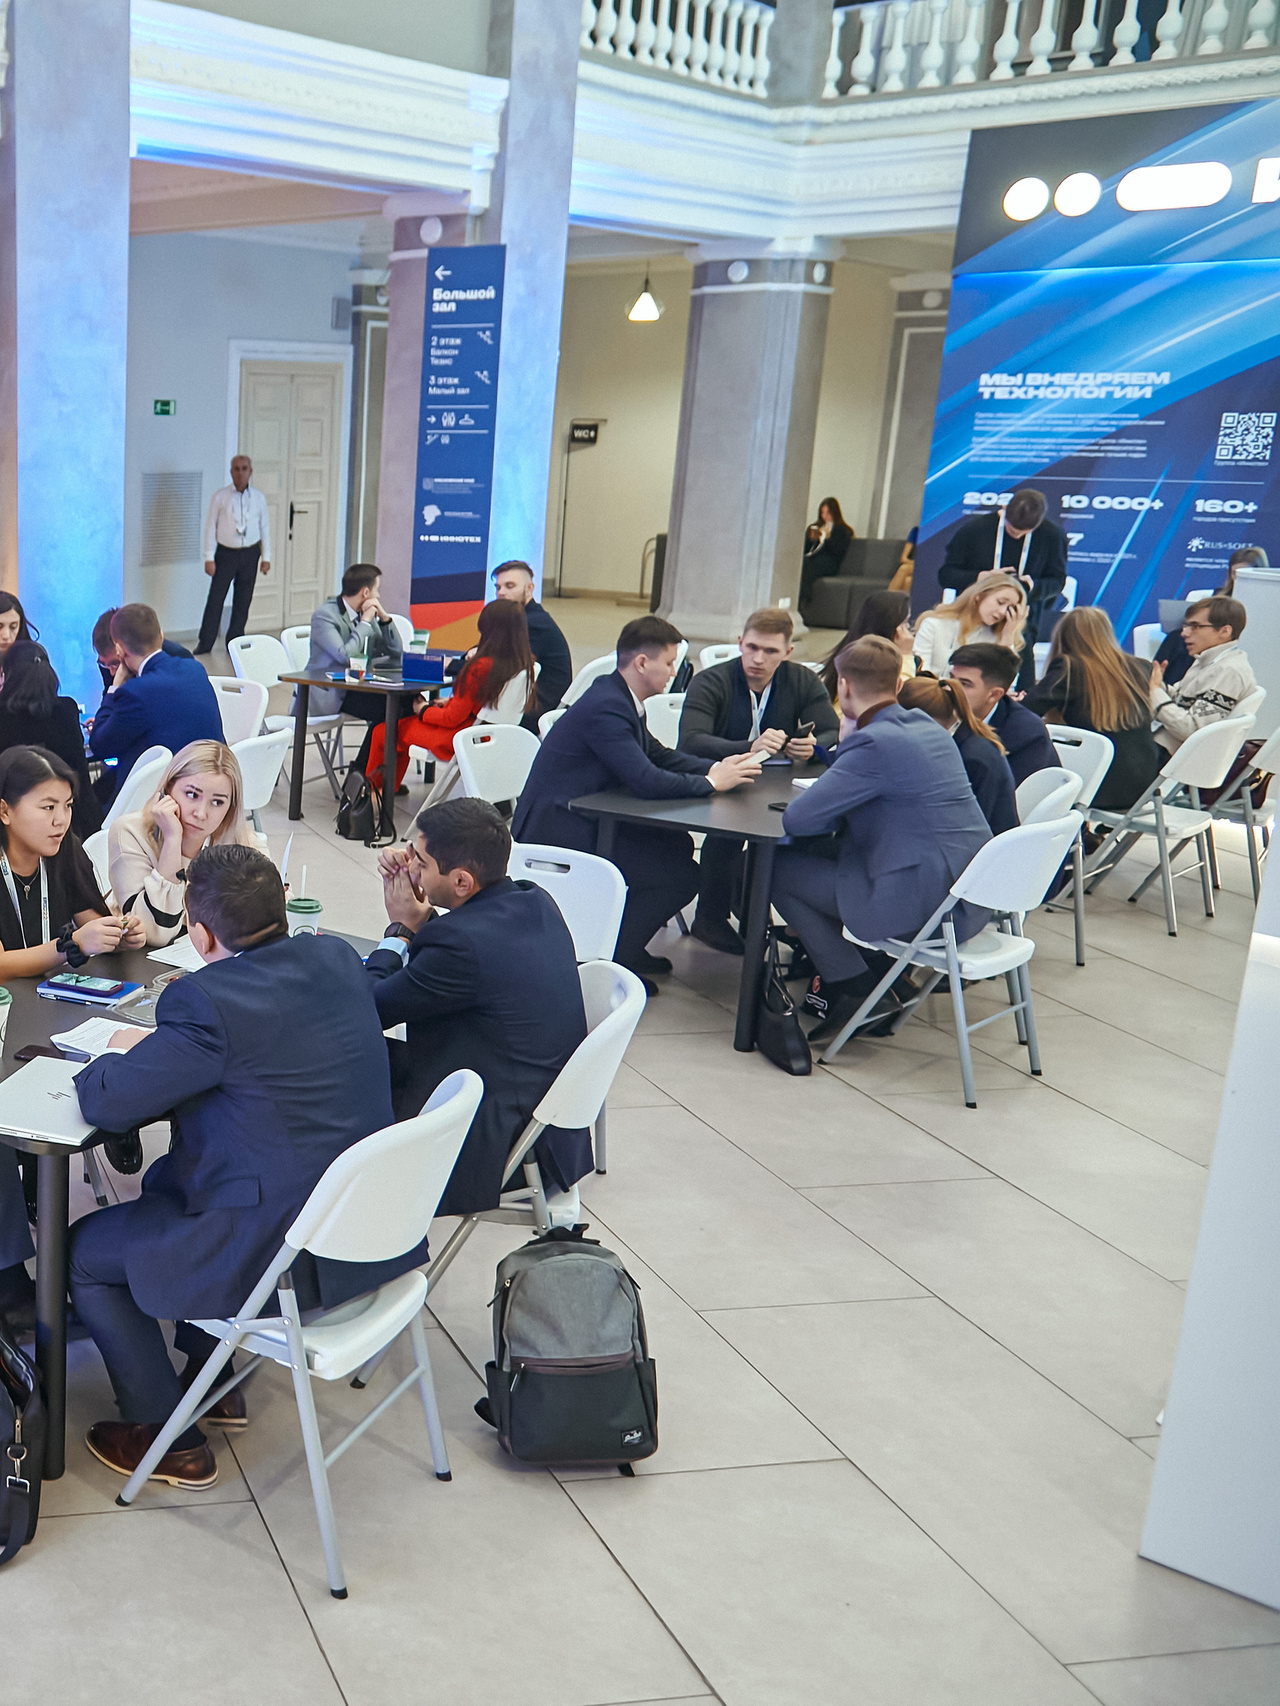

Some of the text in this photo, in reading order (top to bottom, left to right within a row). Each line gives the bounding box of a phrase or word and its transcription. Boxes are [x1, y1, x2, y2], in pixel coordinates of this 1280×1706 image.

[432, 286, 496, 301] Большой
[432, 302, 457, 313] зал
[431, 335, 461, 346] 2 этаж
[979, 372, 1170, 387] МЫ ВНЕДРЯЕМ
[978, 386, 1153, 399] ТЕХНОЛОГИИ
[573, 429, 589, 438] WC
[962, 491, 1014, 506] 202
[1061, 494, 1164, 511] 10 000+
[1194, 499, 1258, 514] 160+
